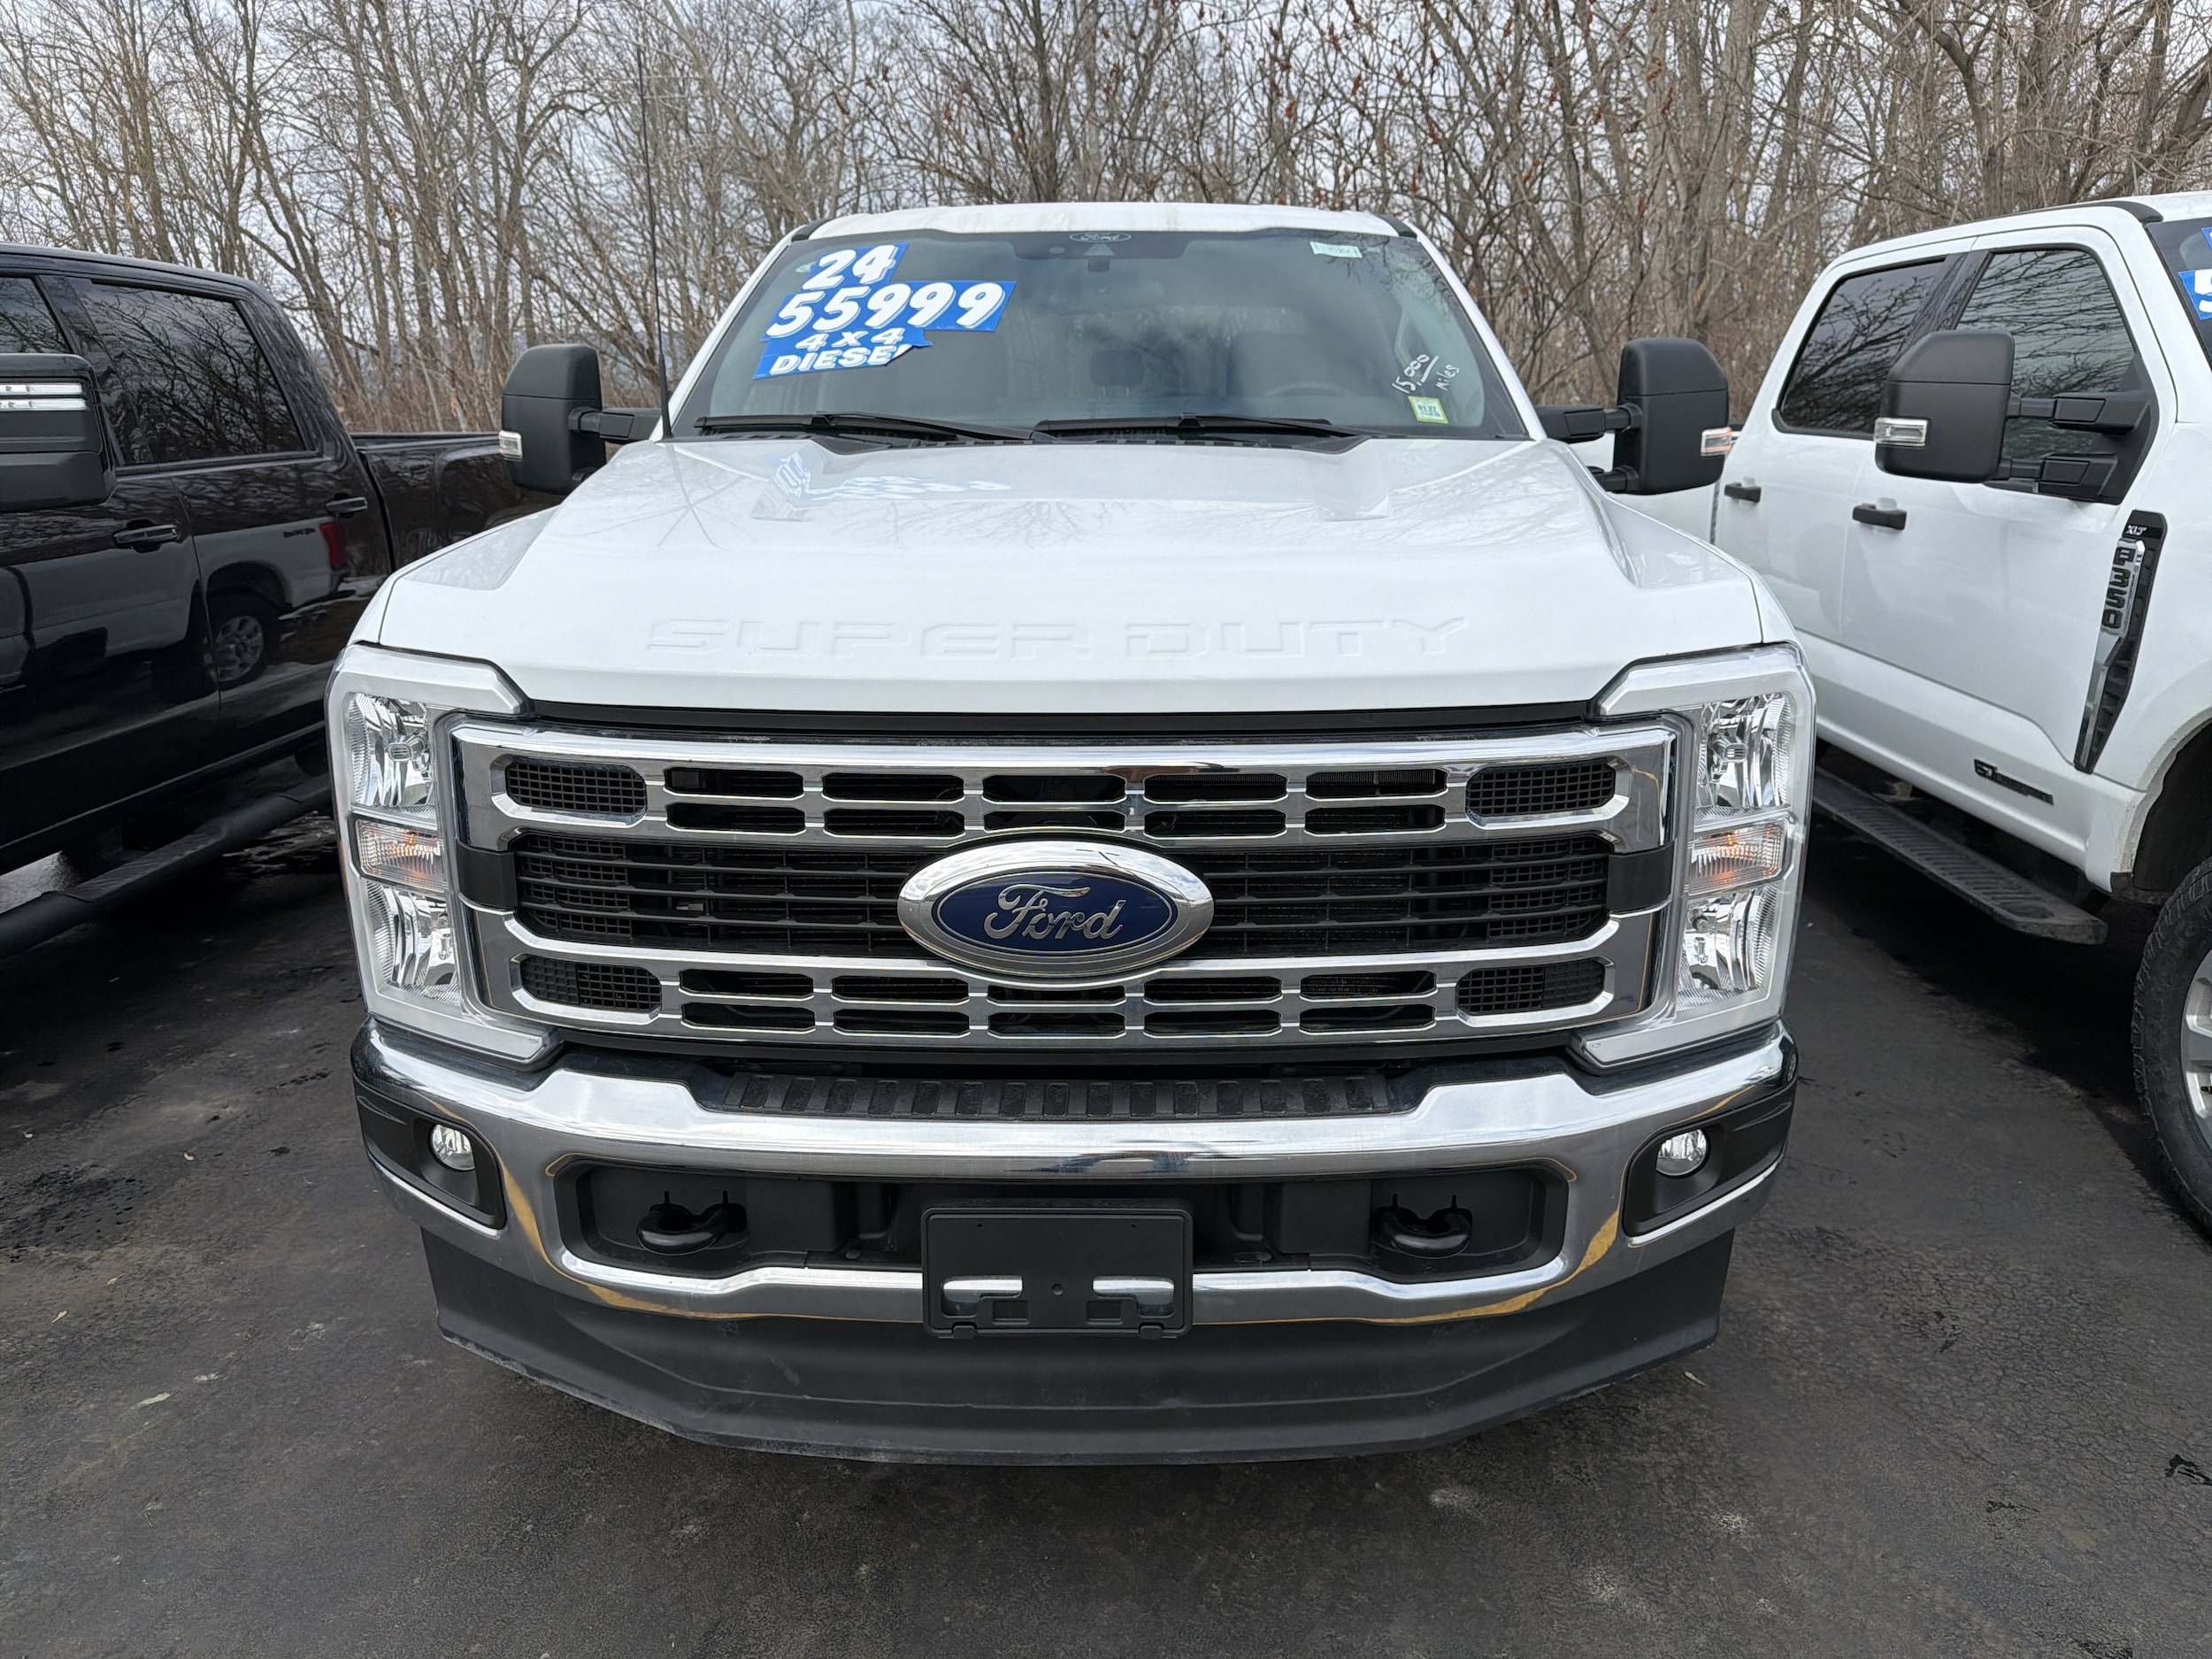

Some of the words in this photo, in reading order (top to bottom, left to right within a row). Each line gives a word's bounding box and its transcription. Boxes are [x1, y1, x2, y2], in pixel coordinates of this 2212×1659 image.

[802, 244, 899, 290] 24
[765, 282, 1005, 337] 55999
[2125, 525, 2147, 535] XLT
[647, 618, 1093, 658] SUPER
[1126, 618, 1468, 658] DUTY
[984, 884, 1126, 940] Ford
